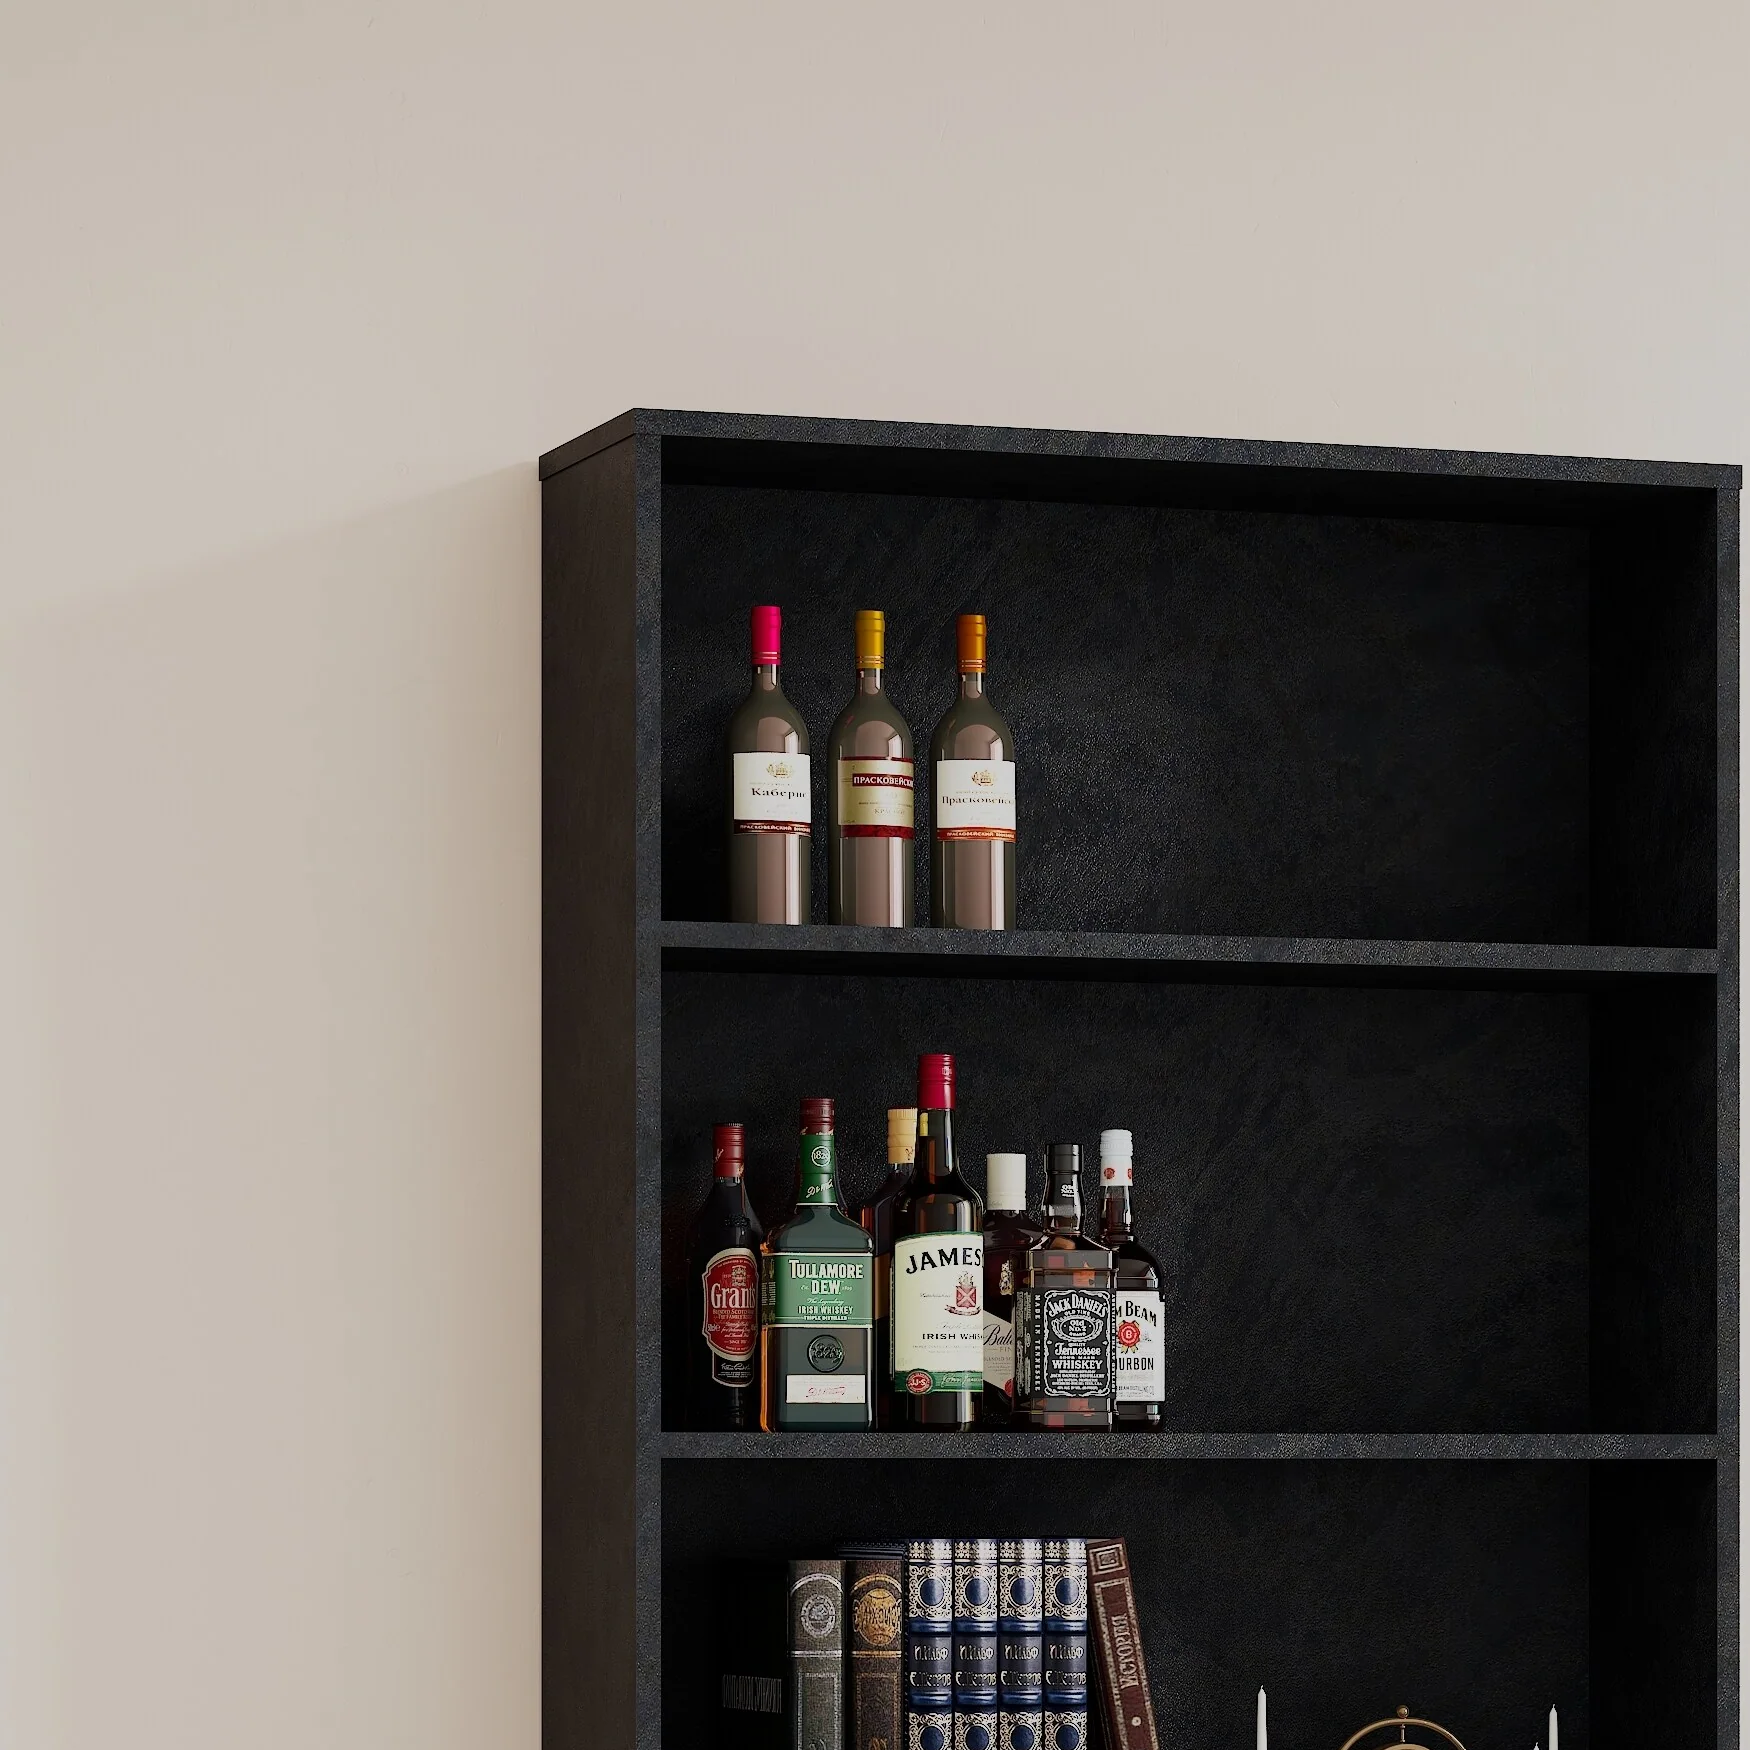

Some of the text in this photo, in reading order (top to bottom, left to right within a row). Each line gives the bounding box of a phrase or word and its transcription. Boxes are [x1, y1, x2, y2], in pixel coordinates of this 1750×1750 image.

[788, 1259, 864, 1279] TULLAMORE
[905, 1247, 985, 1275] JAMES
[798, 1305, 853, 1315] IRISH WHISKEY
[1047, 1297, 1072, 1317] JACK
[1125, 1300, 1157, 1328] BEAM
[1034, 1324, 1041, 1335] IN
[1052, 1359, 1103, 1370] WHISKEY
[1116, 1357, 1154, 1371] URBON
